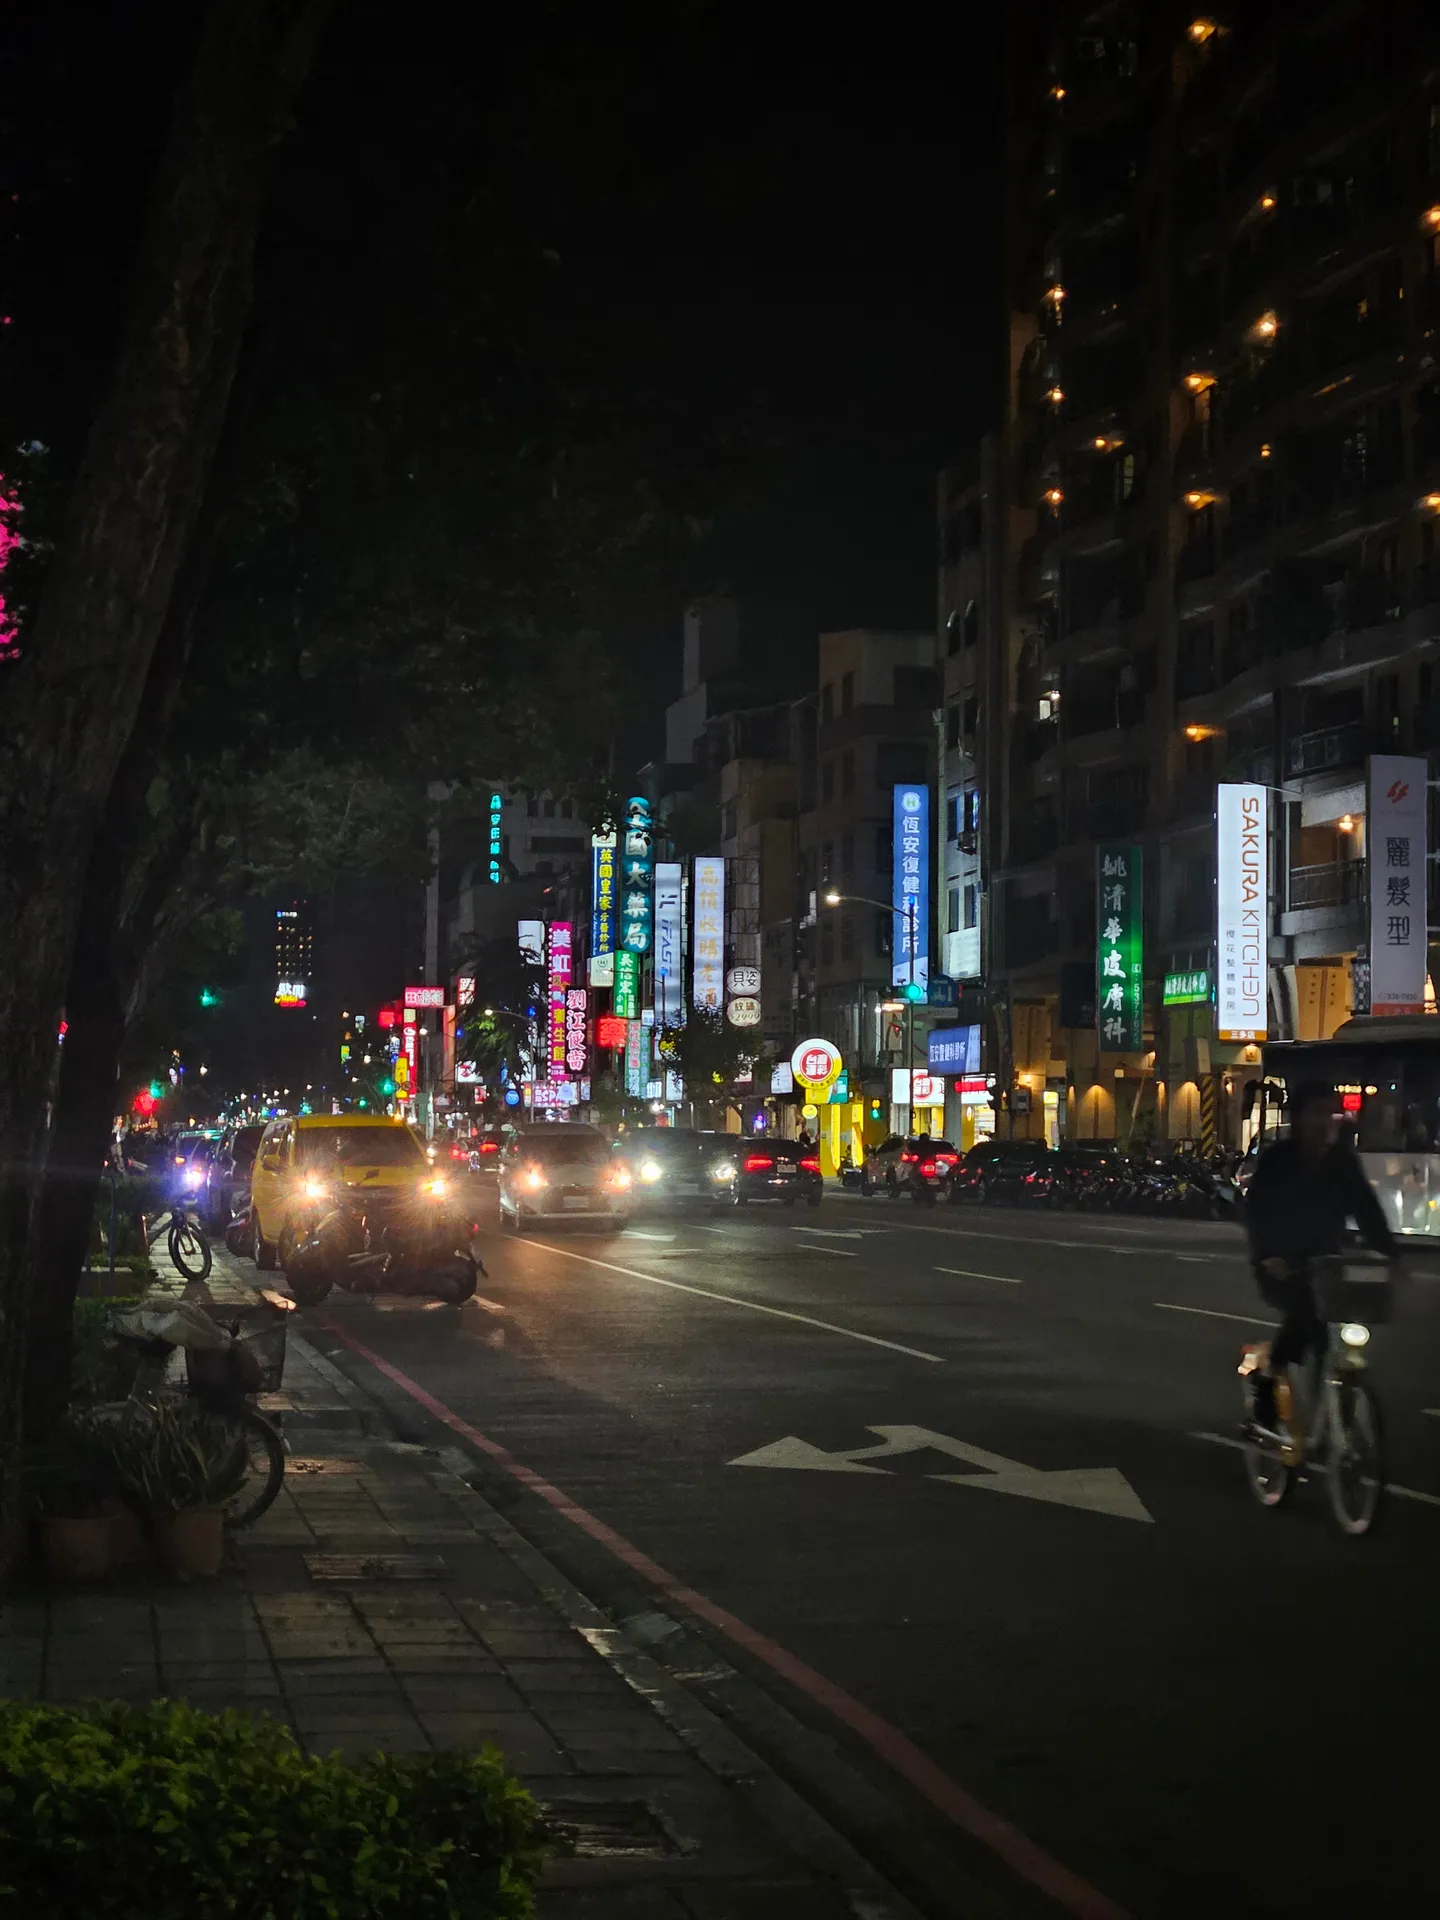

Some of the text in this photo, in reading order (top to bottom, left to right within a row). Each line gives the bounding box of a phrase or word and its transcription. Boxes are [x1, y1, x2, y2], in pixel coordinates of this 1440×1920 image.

[902, 815, 921, 954] 恆安復健科診所
[1242, 797, 1259, 1017] SAKURA KITCHEN
[1386, 837, 1411, 946] 麗髮型
[551, 929, 571, 973] 美虹
[1102, 854, 1128, 1044] 姚清華皮膚科
[566, 989, 587, 1071] 劉江便當
[1231, 1030, 1256, 1040] 三多店
